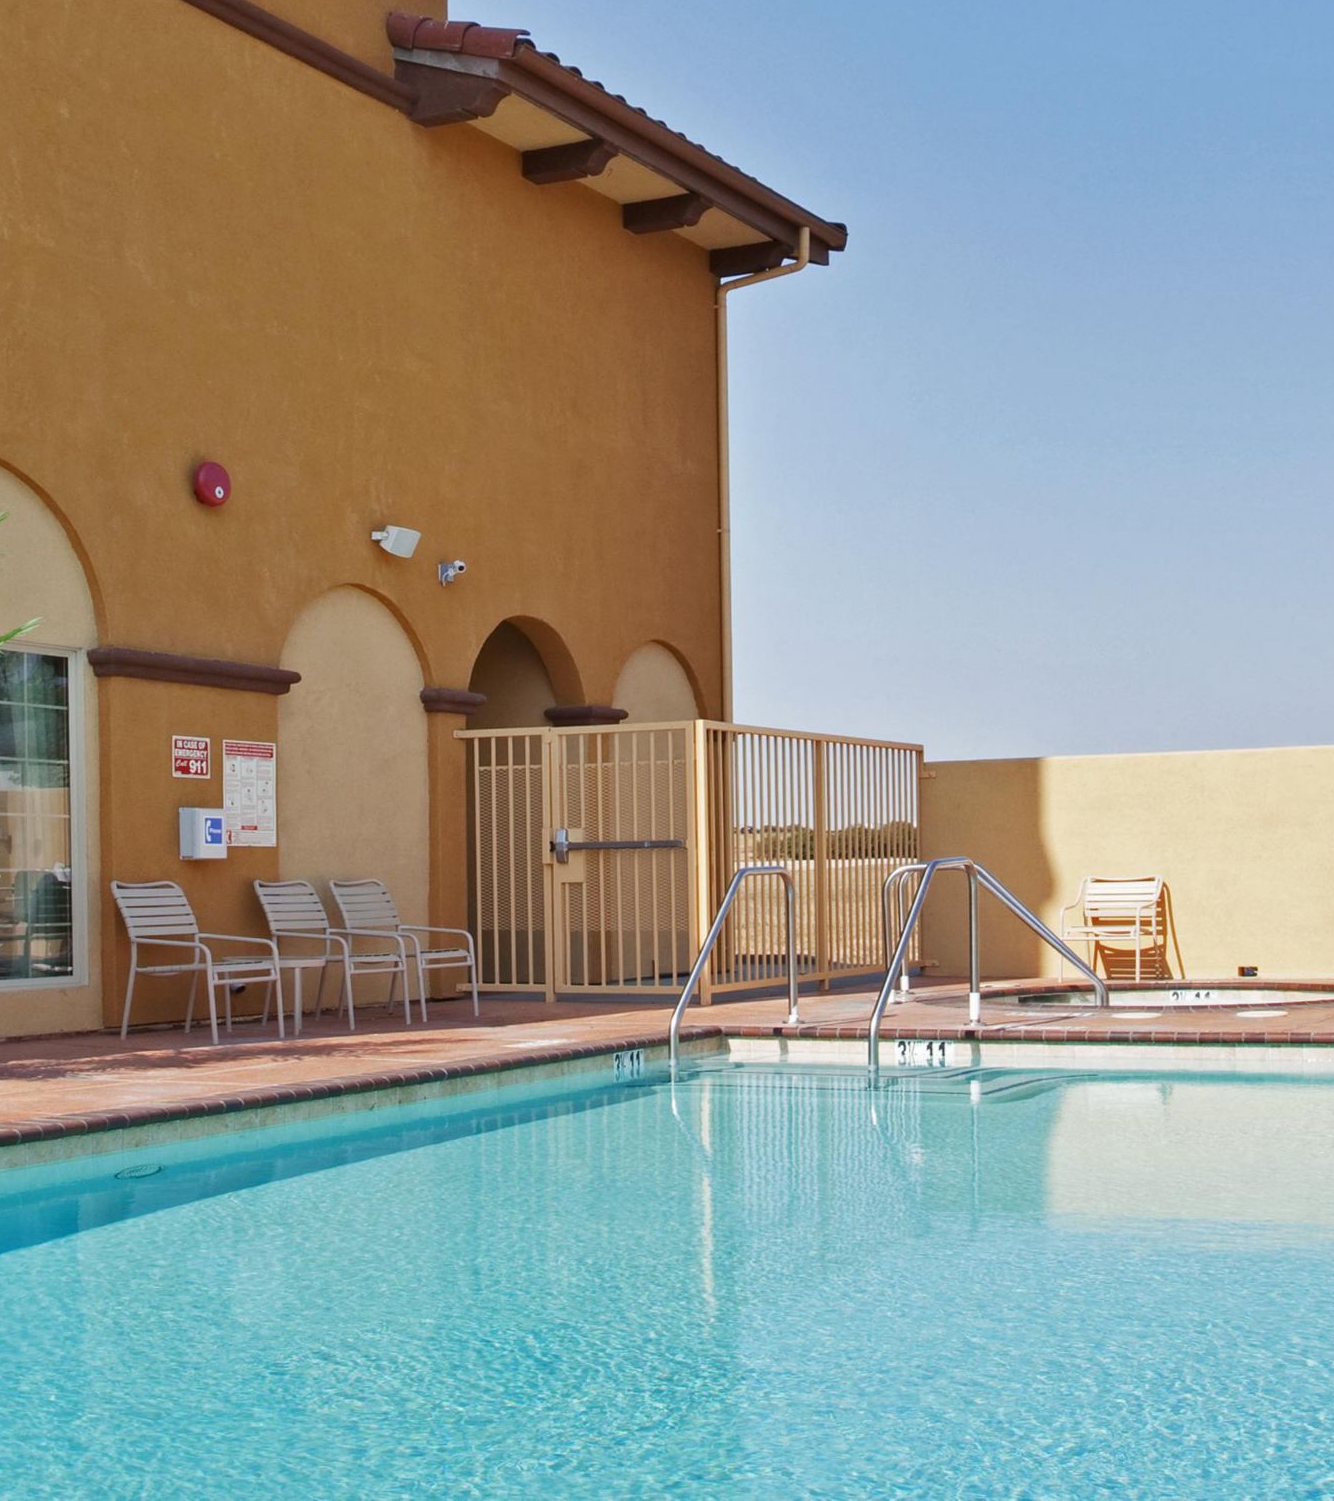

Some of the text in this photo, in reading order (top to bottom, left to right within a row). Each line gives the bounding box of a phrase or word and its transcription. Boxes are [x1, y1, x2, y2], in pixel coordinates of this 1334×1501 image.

[183, 740, 198, 749] CASE
[174, 748, 207, 759] EMERGENCY
[189, 759, 207, 774] 911
